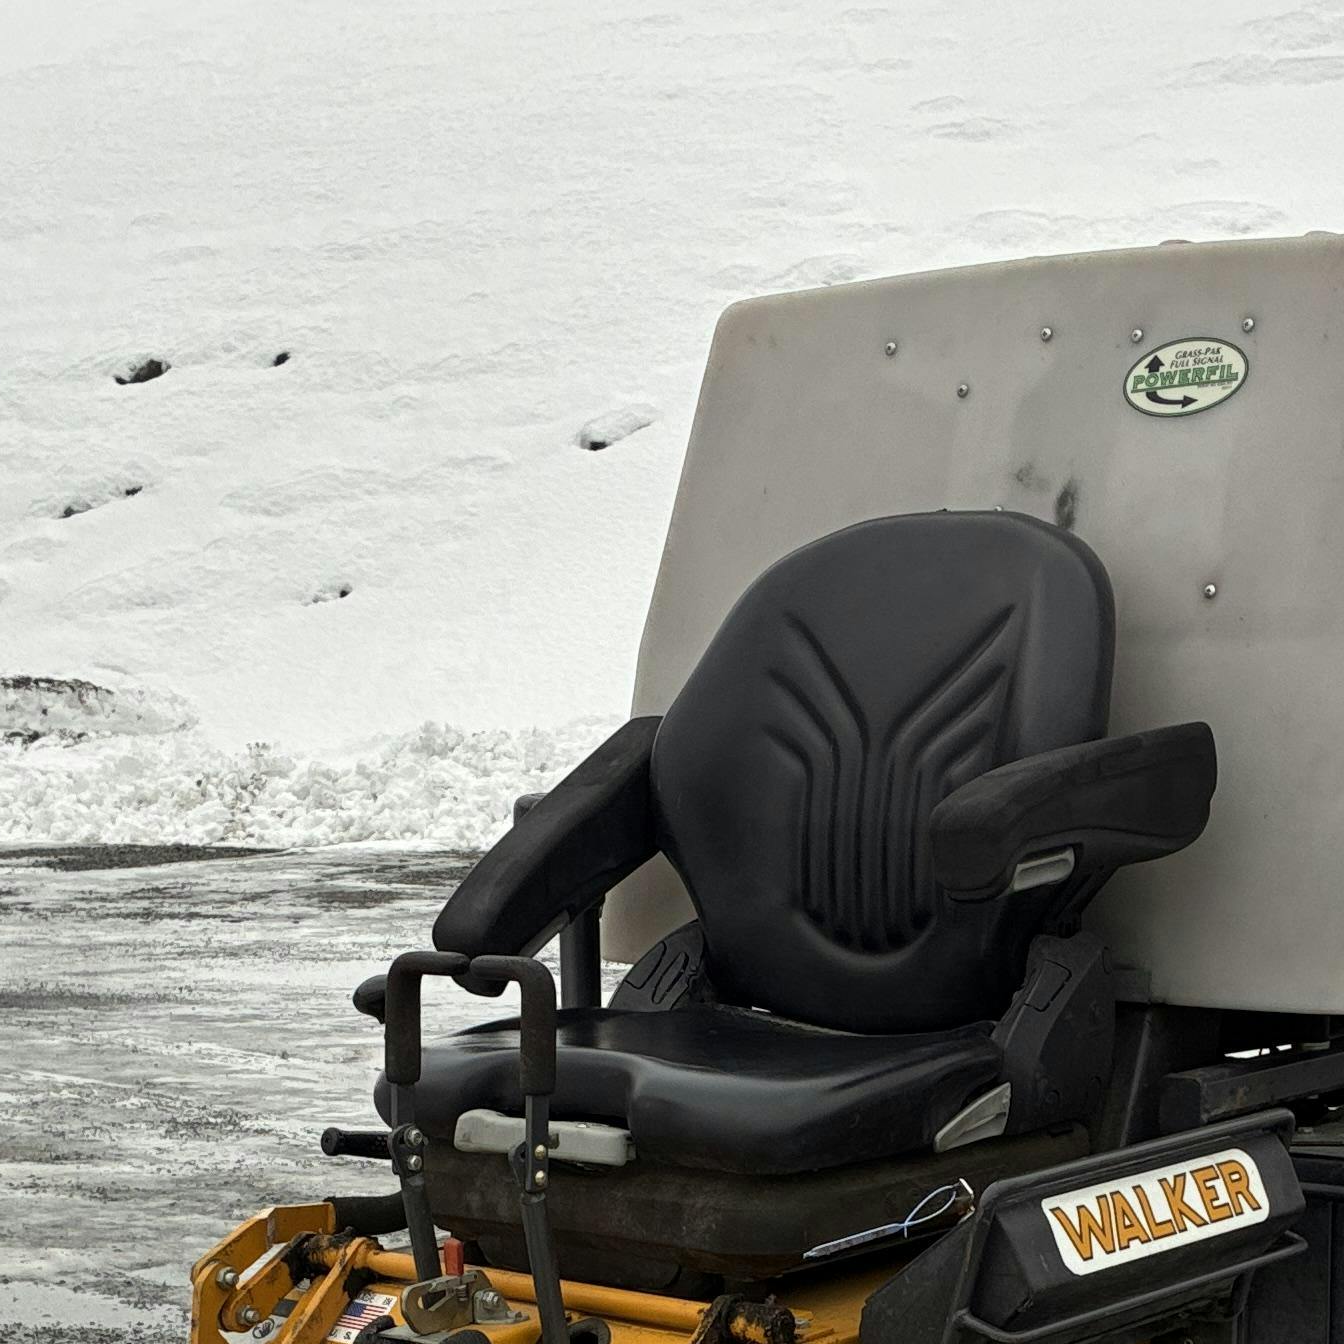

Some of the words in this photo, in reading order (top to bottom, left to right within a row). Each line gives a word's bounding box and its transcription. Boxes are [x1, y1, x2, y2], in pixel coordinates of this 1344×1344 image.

[1169, 359, 1190, 370] FULL
[1192, 355, 1224, 367] SIGNAL
[1131, 363, 1239, 391] POWERFIL
[1049, 1159, 1262, 1262] WALKER
